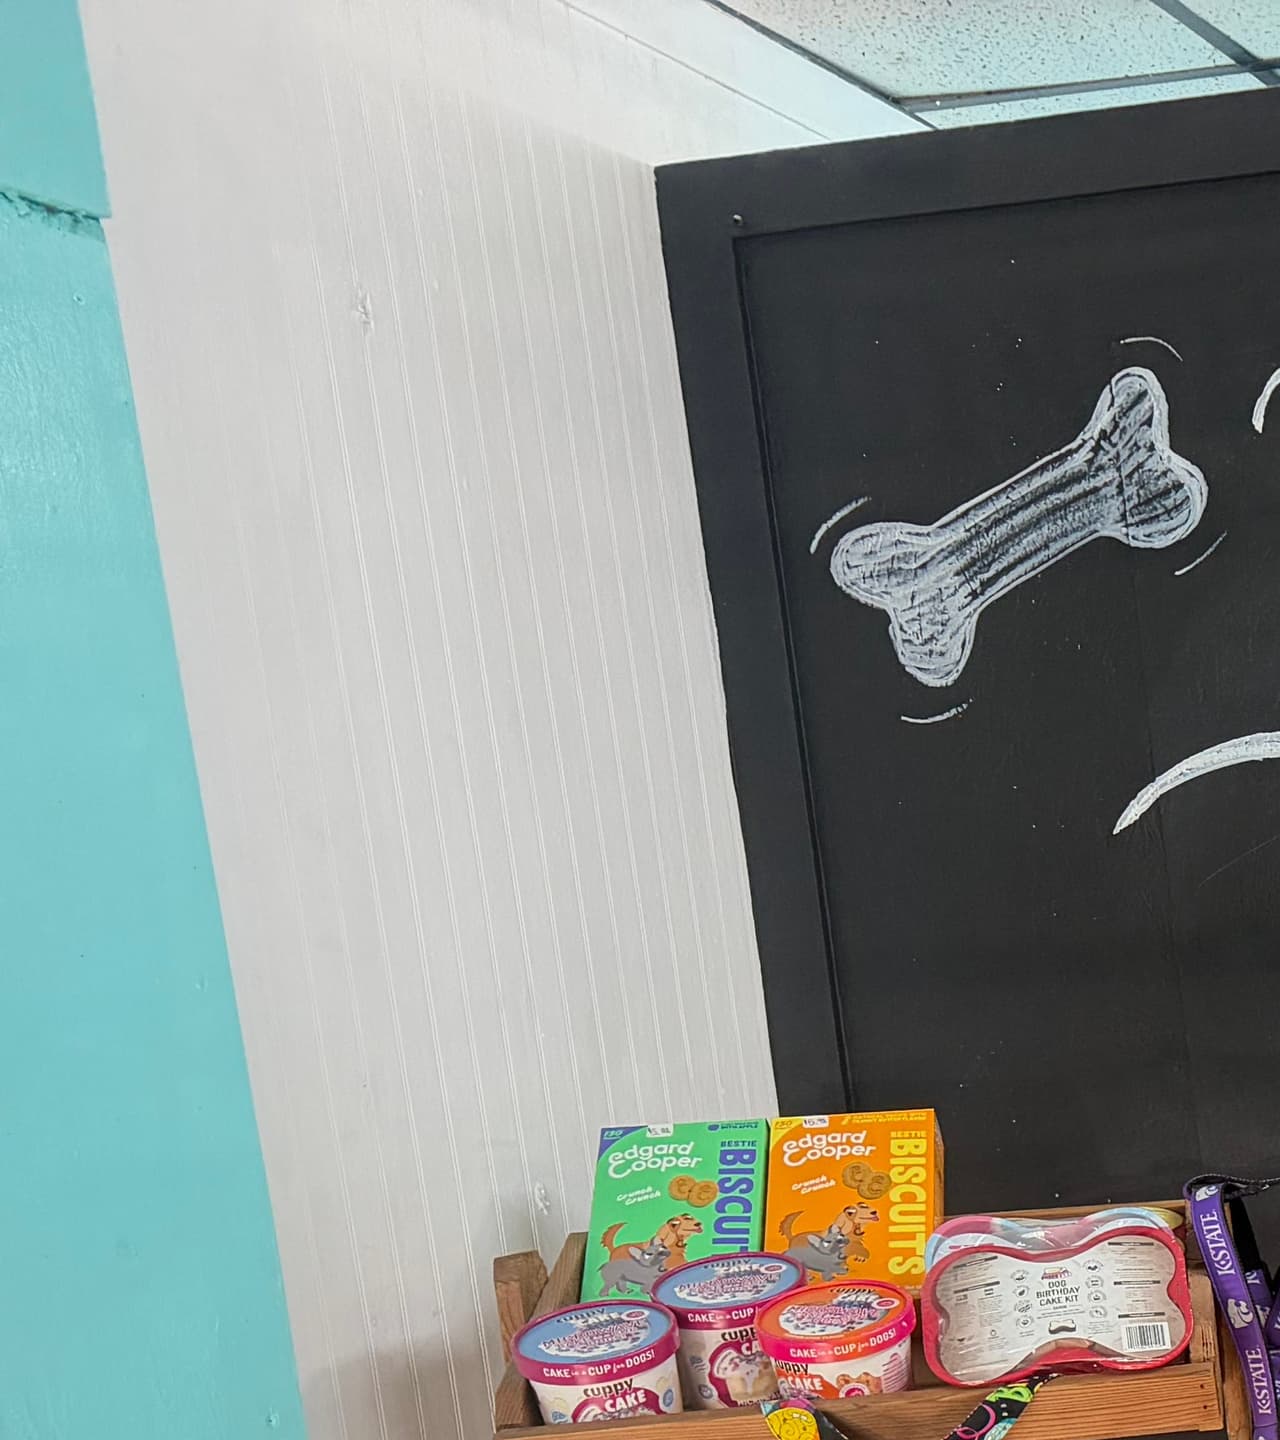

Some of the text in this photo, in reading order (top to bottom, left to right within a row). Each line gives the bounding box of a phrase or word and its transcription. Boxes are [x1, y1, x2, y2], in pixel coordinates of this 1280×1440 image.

[887, 1138, 928, 1275] BISCUITS
[1036, 1286, 1081, 1299] BIRTHDAY
[1040, 1295, 1078, 1306] CAKE KIT
[789, 1348, 818, 1359] CAKE
[833, 1344, 857, 1355] CUP
[543, 1366, 572, 1378] CAKE
[587, 1364, 612, 1376] CUP
[604, 1389, 648, 1413] CAKE
